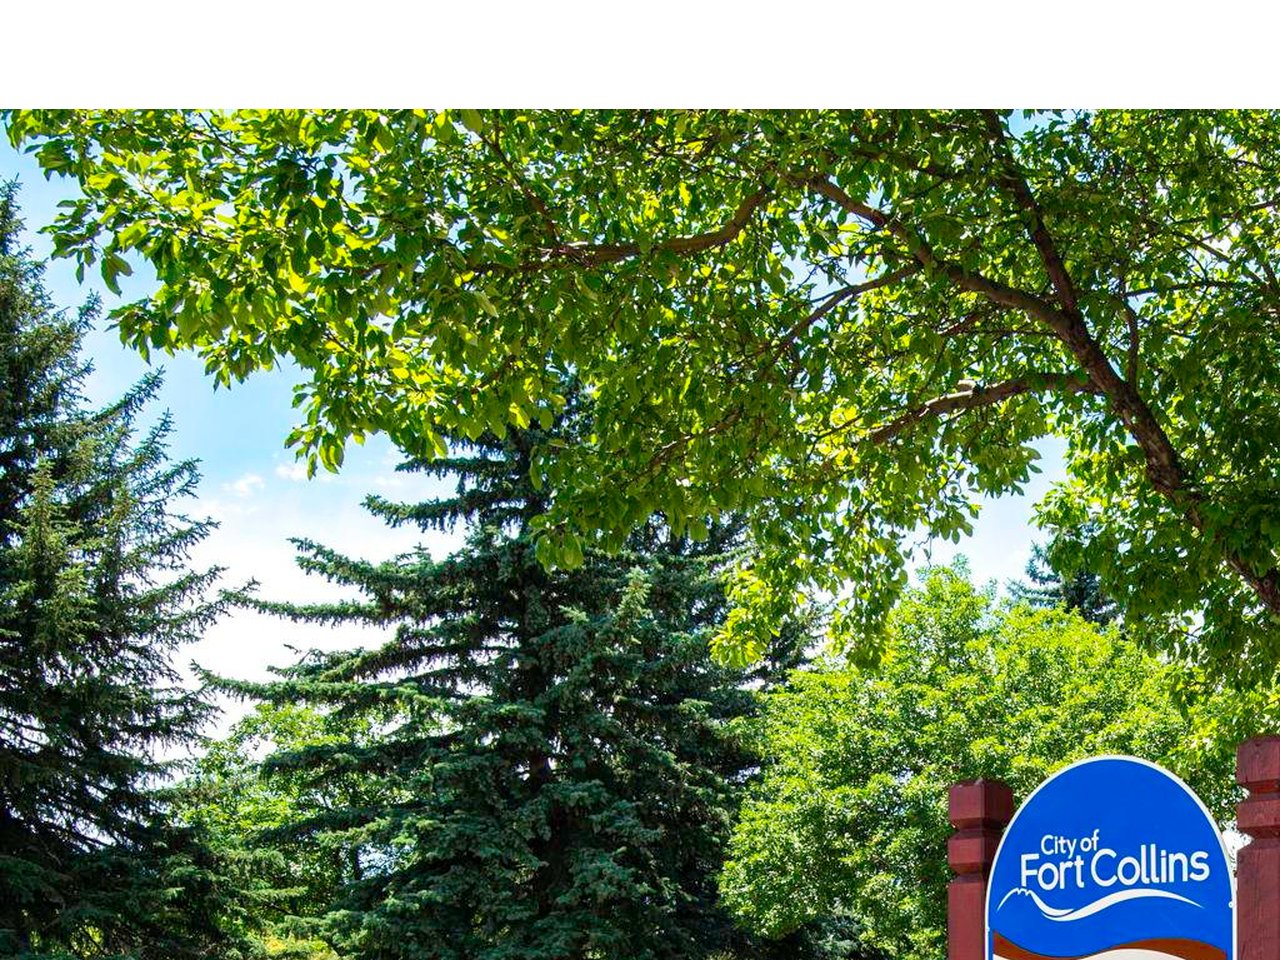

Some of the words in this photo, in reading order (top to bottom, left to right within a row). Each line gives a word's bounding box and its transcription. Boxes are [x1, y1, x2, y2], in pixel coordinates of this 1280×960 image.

[1041, 834, 1076, 857] City
[1079, 829, 1100, 852] of
[1020, 853, 1085, 891] Fort
[1090, 844, 1211, 887] Collins
